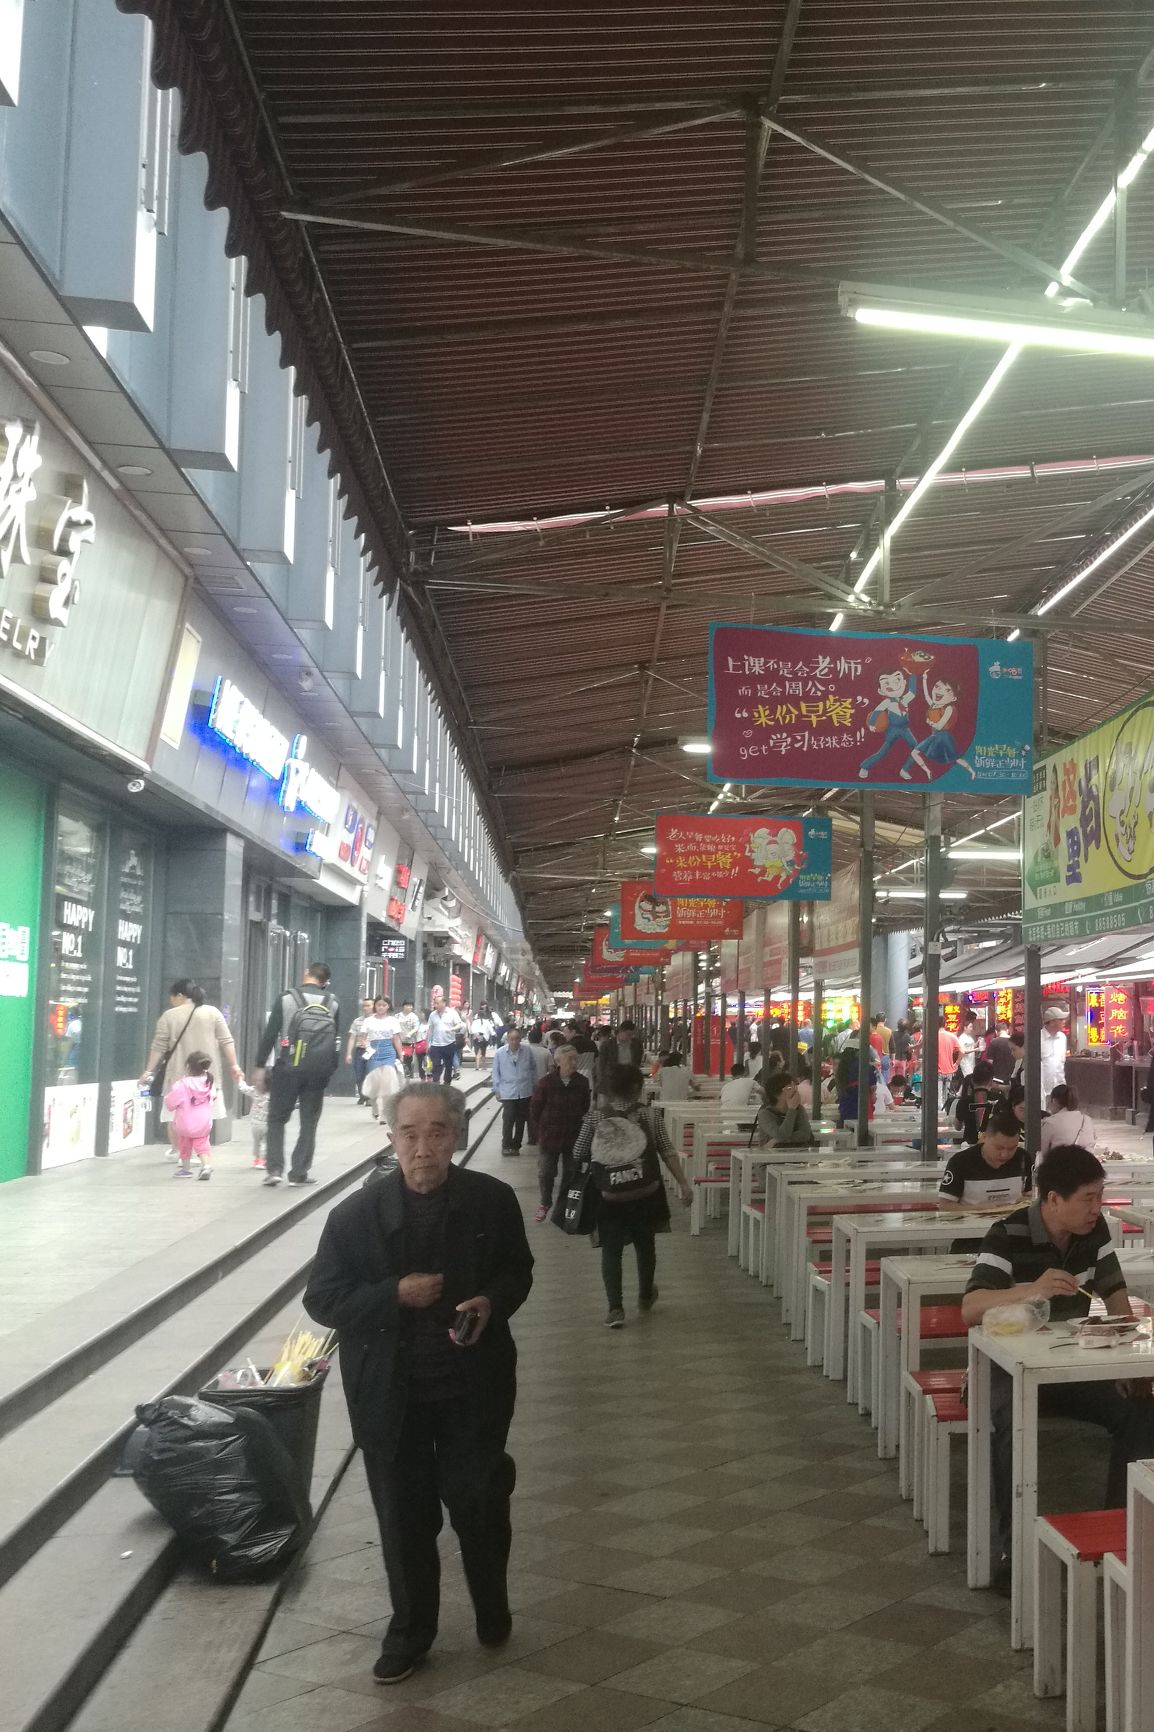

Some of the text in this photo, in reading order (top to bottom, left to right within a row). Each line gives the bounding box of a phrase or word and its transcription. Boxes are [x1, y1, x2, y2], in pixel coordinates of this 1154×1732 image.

[724, 654, 862, 680] 上课不是会老师
[63, 900, 95, 932] HAPPY
[117, 919, 143, 944] HAPPY
